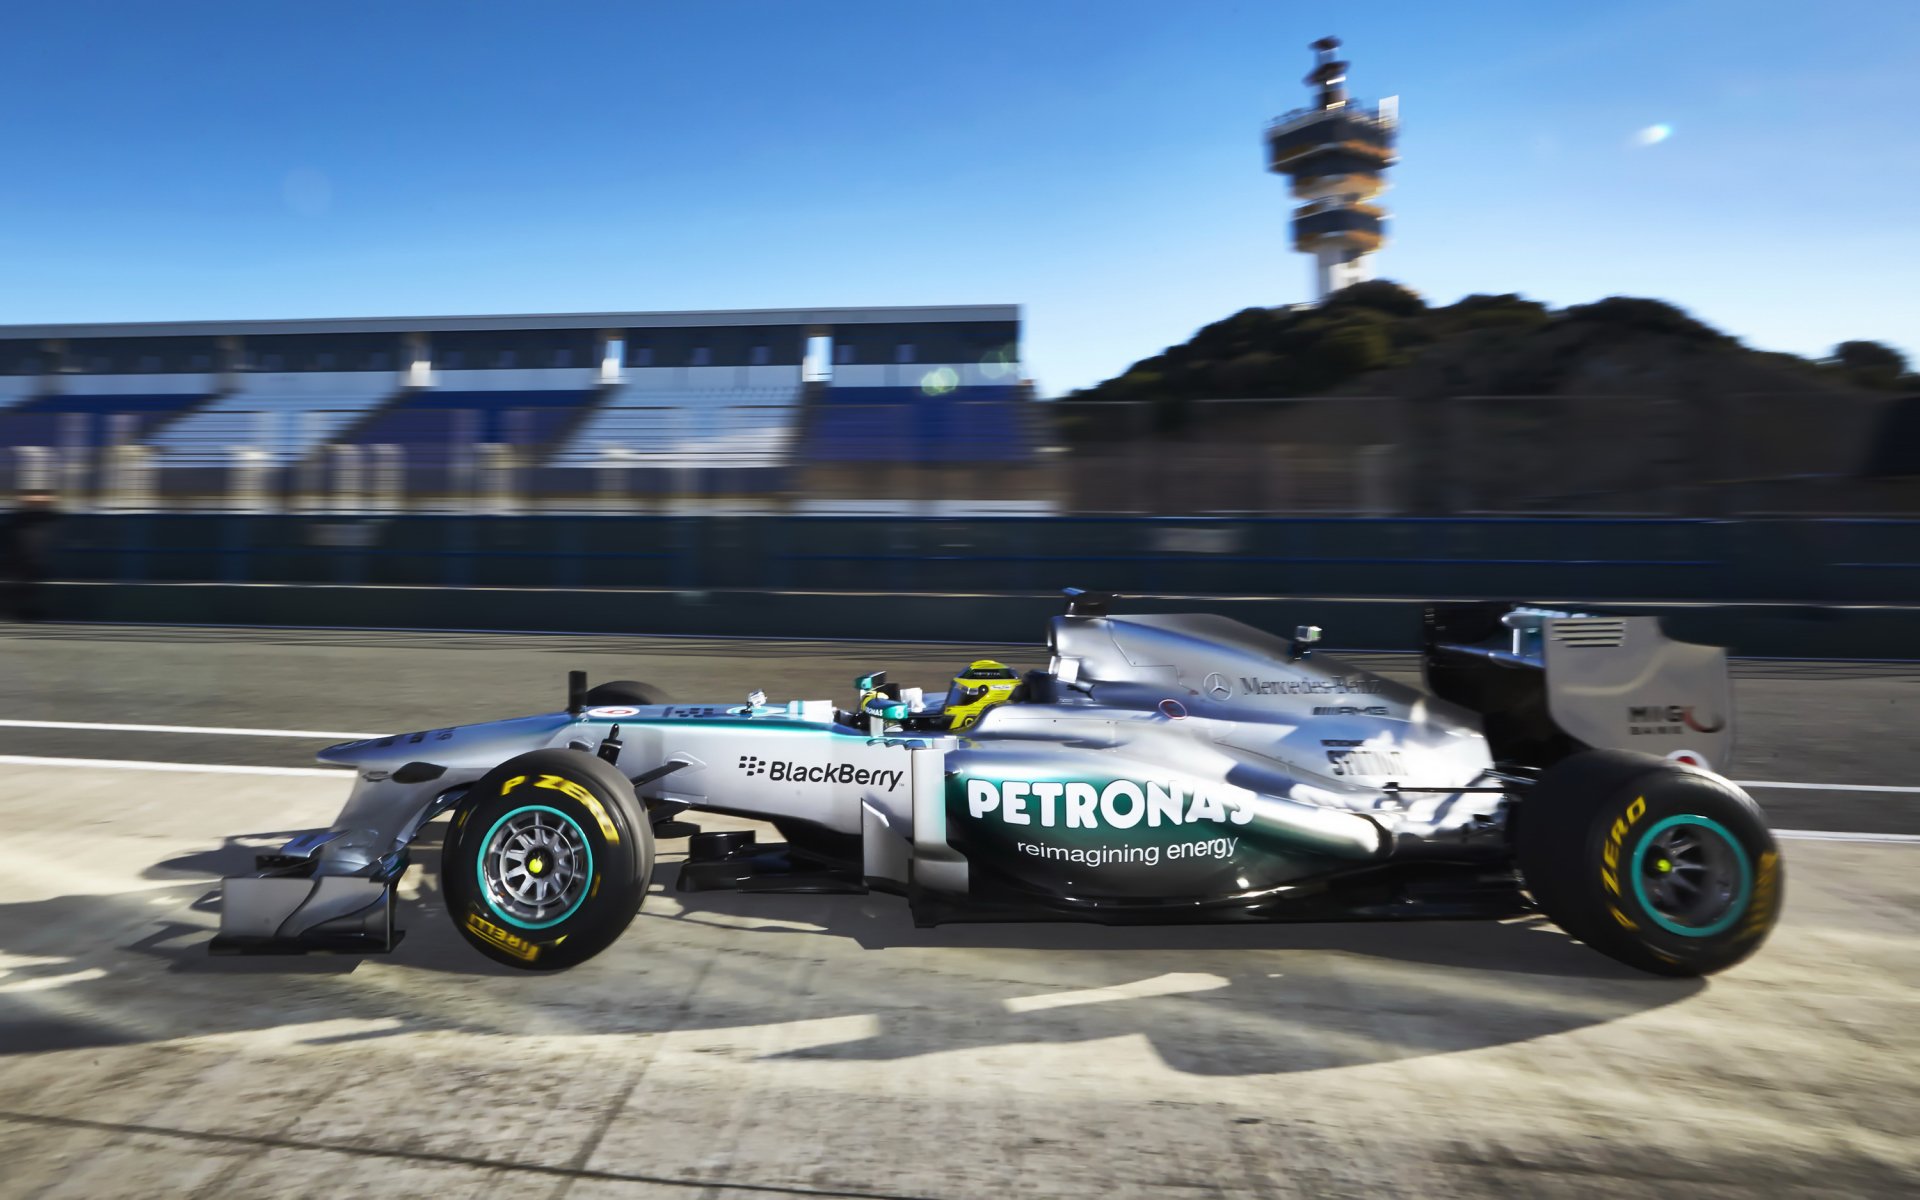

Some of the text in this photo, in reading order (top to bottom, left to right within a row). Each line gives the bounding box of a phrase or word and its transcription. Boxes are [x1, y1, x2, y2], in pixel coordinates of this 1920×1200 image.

[501, 775, 526, 796] P
[769, 761, 904, 792] BlackBerry
[967, 779, 1257, 829] PETRONAS
[1017, 836, 1239, 867] reimagining energy
[1602, 795, 1647, 896] ZERO
